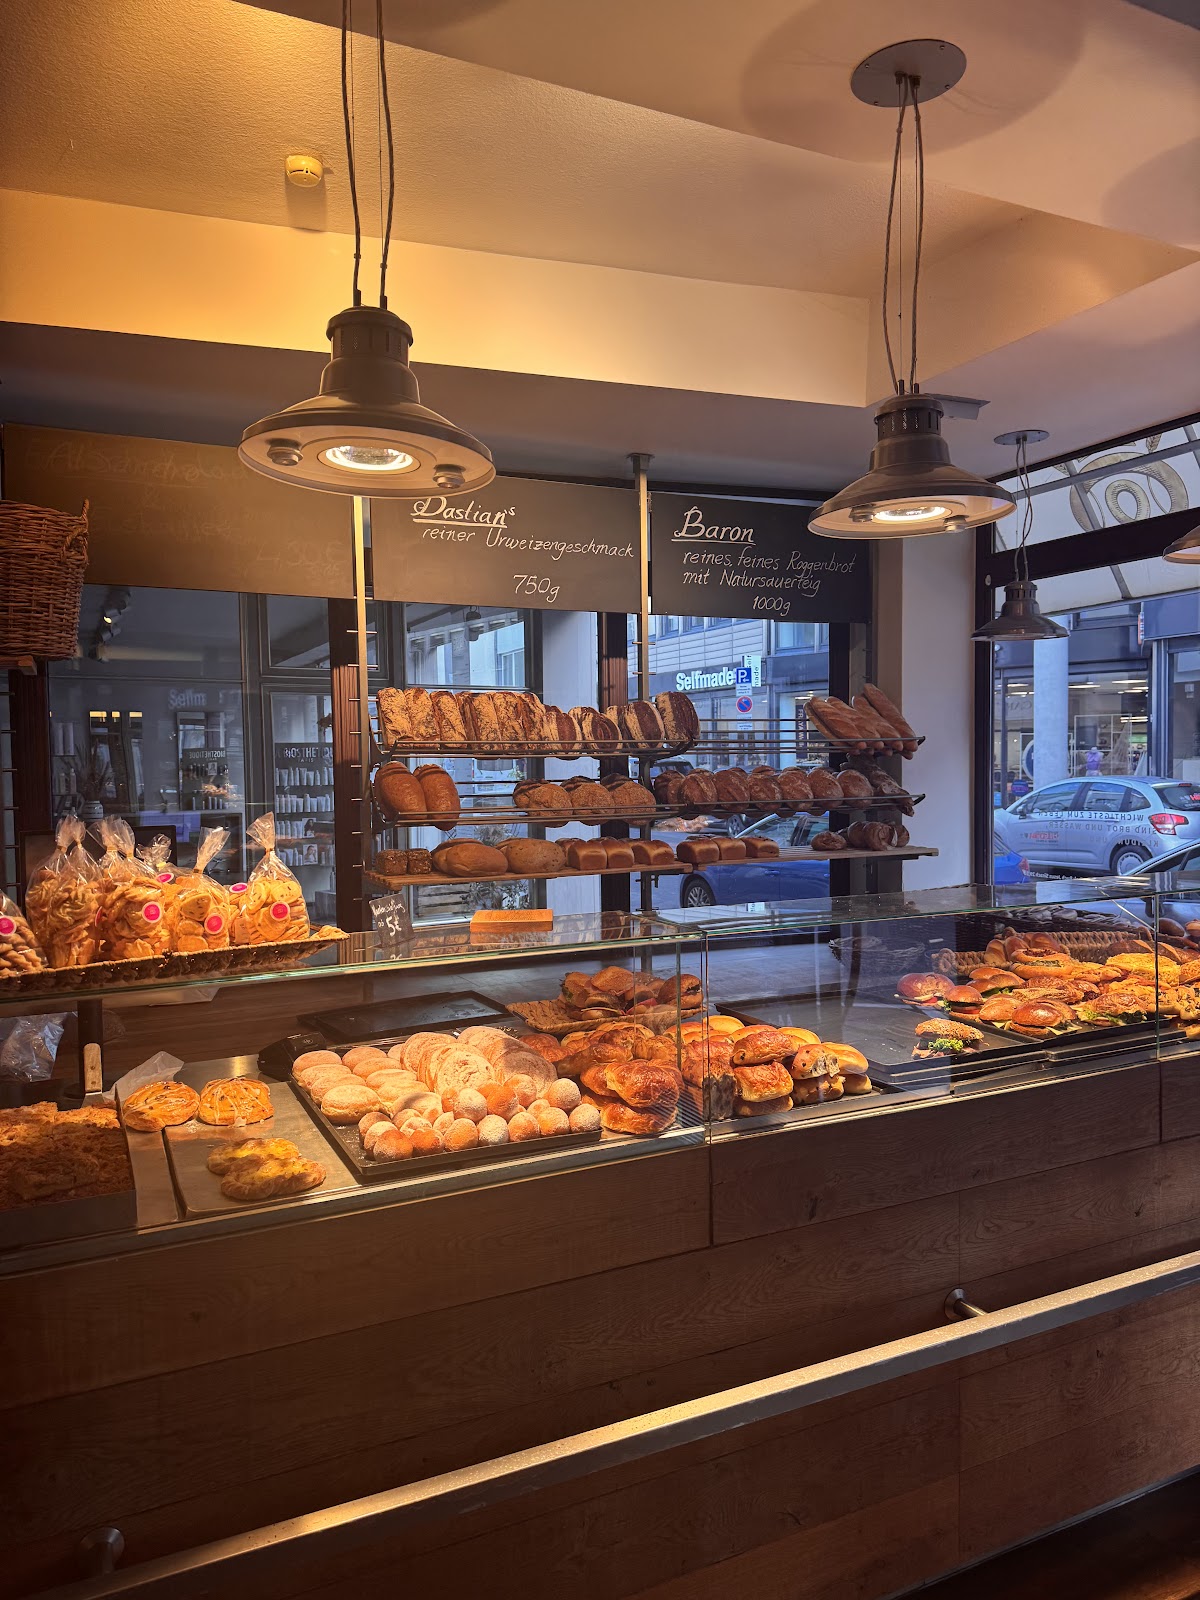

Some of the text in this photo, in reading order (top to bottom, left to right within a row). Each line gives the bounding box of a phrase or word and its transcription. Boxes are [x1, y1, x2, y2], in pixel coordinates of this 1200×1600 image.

[673, 506, 755, 543] Baron
[422, 526, 635, 561] reiner Urweizengeschmack
[737, 546, 780, 571] feines
[786, 550, 857, 578] Roggenbrot
[513, 574, 560, 603] 750g
[682, 568, 822, 597] mit Natursauerteig
[752, 595, 791, 617] 1000g
[676, 666, 733, 691] Selfmade
[738, 669, 747, 684] P
